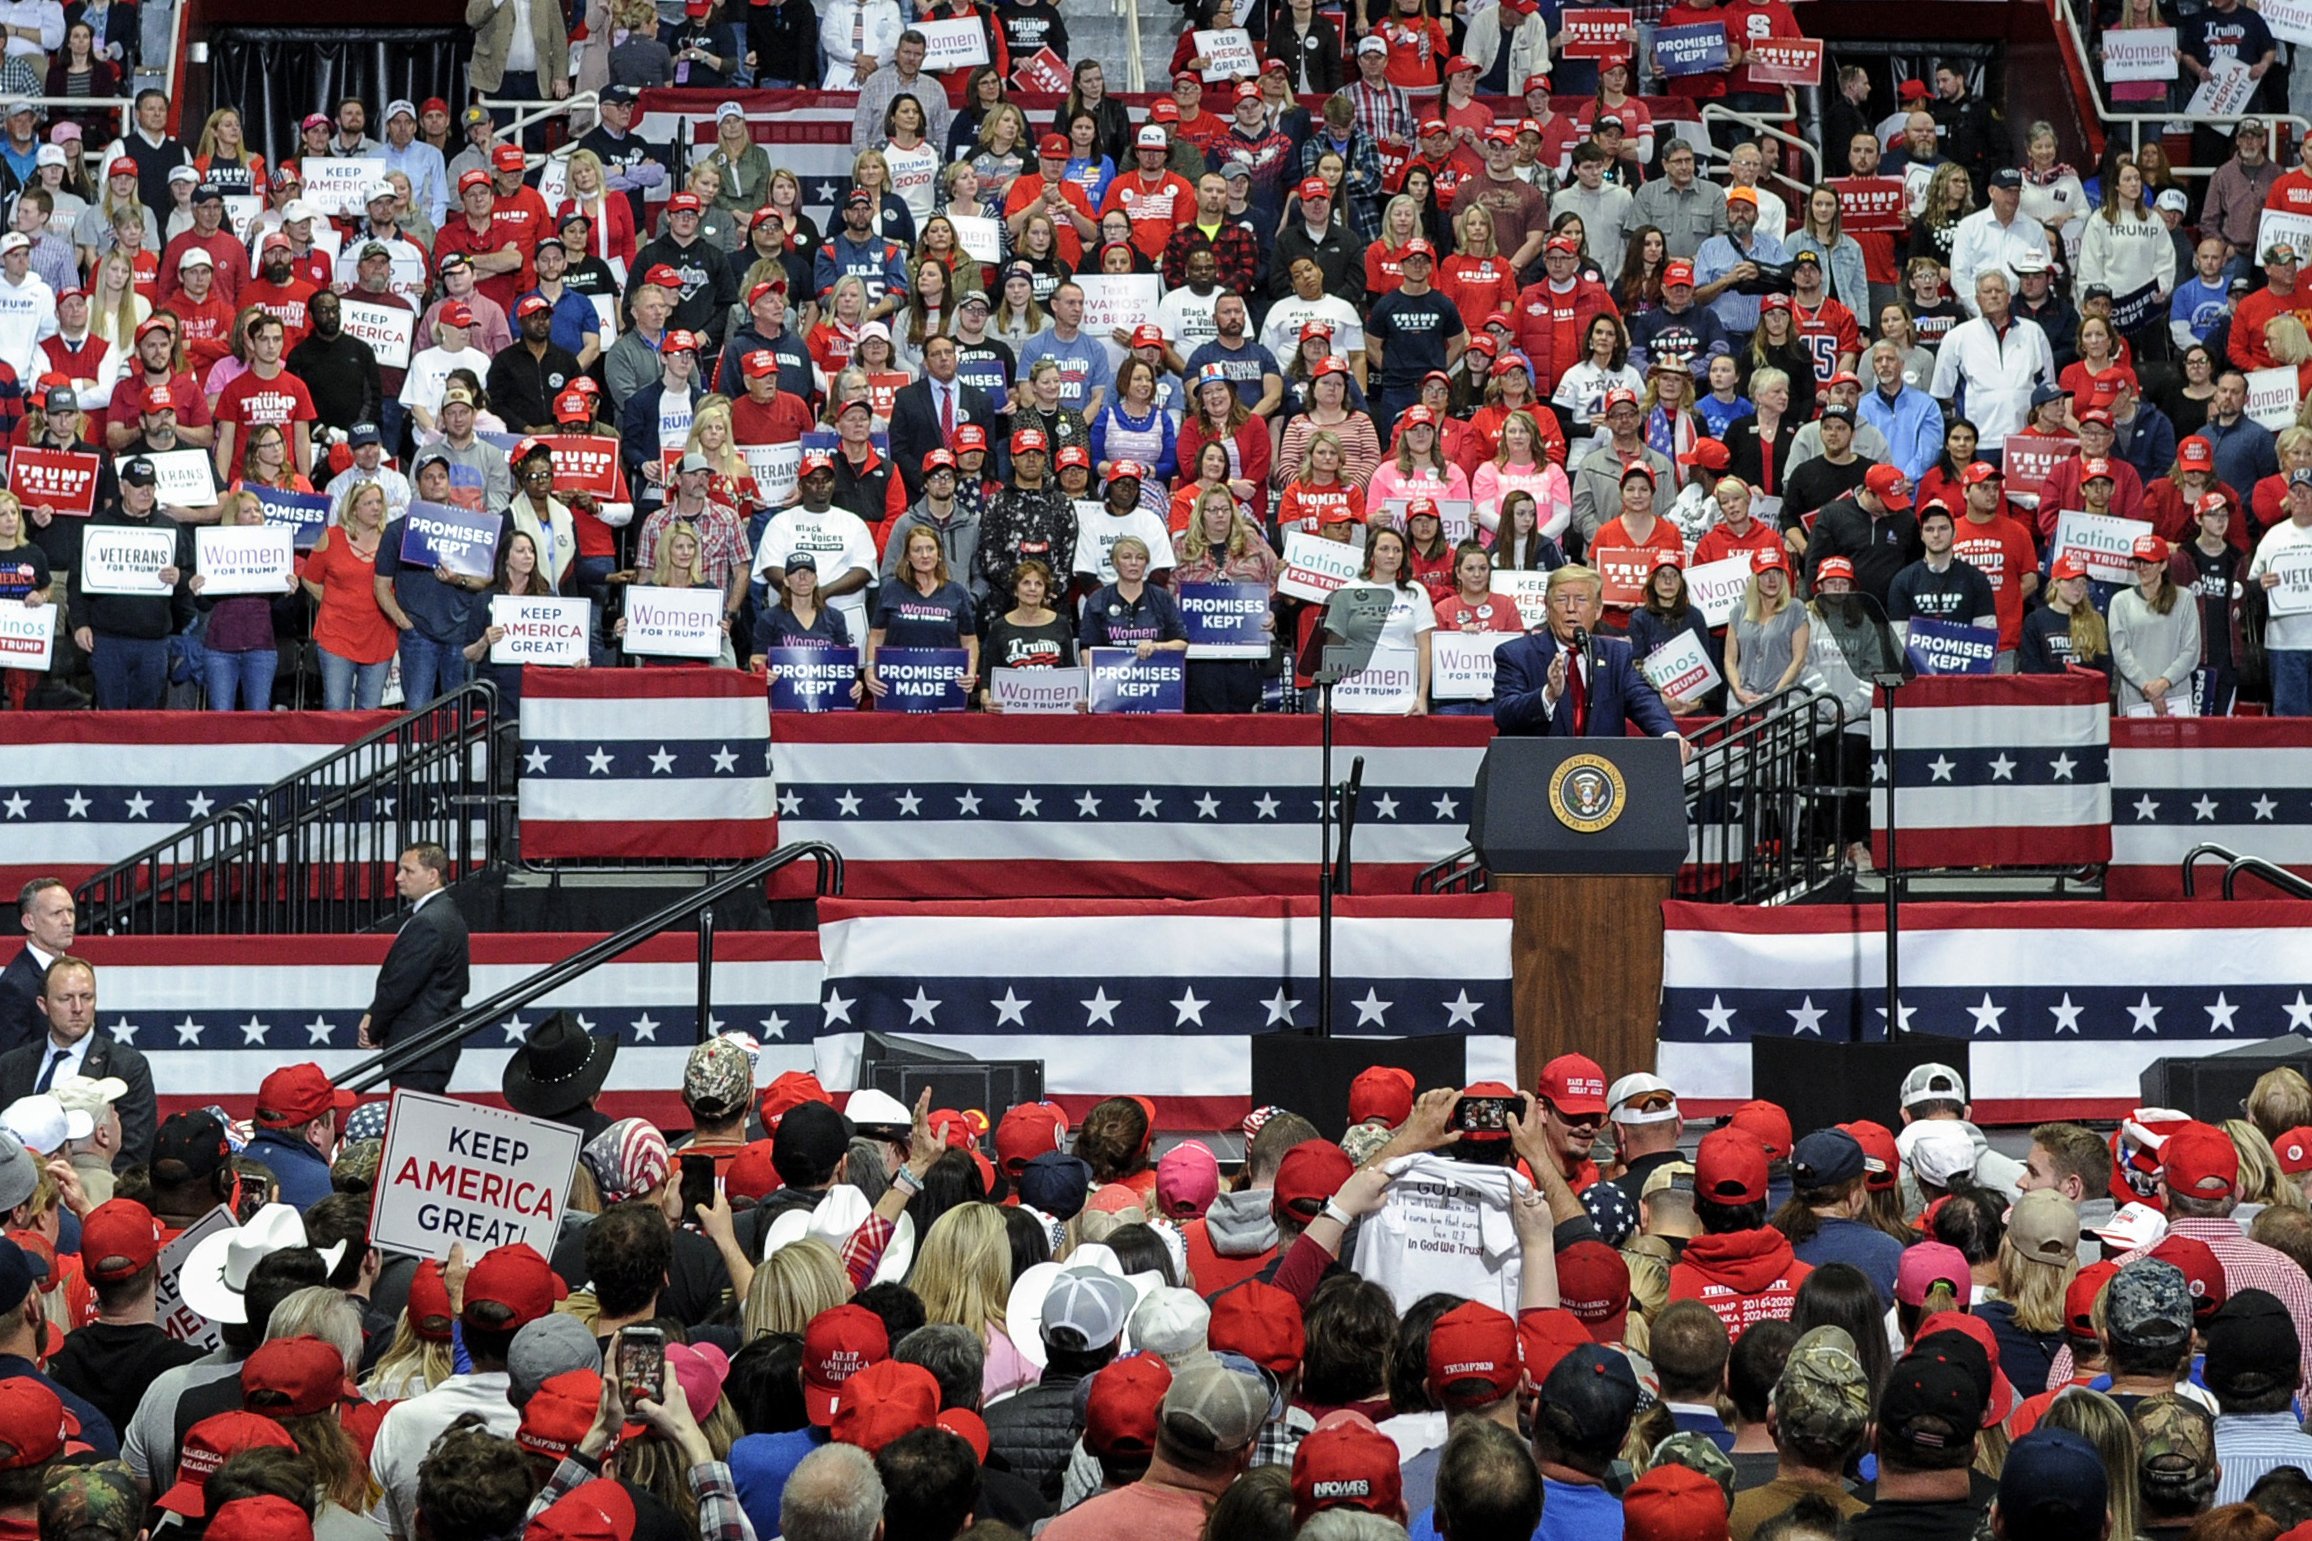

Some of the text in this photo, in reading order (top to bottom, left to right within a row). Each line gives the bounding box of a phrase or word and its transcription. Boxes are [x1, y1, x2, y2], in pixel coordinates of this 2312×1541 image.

[1009, 21, 1051, 32] TRUMP
[1568, 23, 1627, 33] TRUMP
[2204, 21, 2246, 38] Trump
[1214, 36, 1237, 47] KEEP
[1656, 34, 1724, 52] PROMISES
[1205, 48, 1253, 62] AMERICA
[1674, 50, 1708, 63] KEPT
[1756, 47, 1817, 60] TRUMP
[2108, 43, 2172, 60] Women
[2208, 44, 2239, 57] 2020
[1214, 61, 1251, 74] GREAT!
[1761, 57, 1810, 68] PENCE
[2139, 59, 2166, 67] TRUMP
[326, 167, 361, 177] KEEP
[891, 159, 933, 171] TRUMP
[895, 173, 932, 187] 2020
[308, 181, 371, 195] AMERIC
[1842, 192, 1899, 204] RUMP
[2167, 191, 2185, 204] USA
[2105, 224, 2159, 239] TRUMP
[1101, 284, 1130, 300] Text
[351, 311, 389, 325] KEEP
[1181, 308, 1209, 319] Black
[1392, 313, 1440, 322] TRUMP
[1084, 314, 1098, 328] to
[344, 324, 406, 344] MERICA
[1650, 337, 1699, 349] TRUMP
[1585, 379, 1624, 392] PRAY
[241, 396, 297, 412] TRUMP
[252, 409, 288, 420] PENCE
[550, 451, 612, 465] RUMP
[2010, 451, 2069, 466] TRUM
[17, 464, 92, 482] TRUMP
[556, 463, 605, 474] ENCE
[22, 478, 82, 493] PENCE
[765, 475, 797, 488] TRUMP
[1296, 489, 1348, 505] WOMEN
[261, 501, 326, 524] OMISES
[409, 515, 495, 546] PROMISES
[796, 525, 822, 537] Black
[426, 534, 471, 557] KEPT
[811, 534, 844, 546] Voices
[1974, 538, 2002, 550] BLESS
[100, 547, 168, 566] VETERANS
[203, 545, 286, 568] Women
[1290, 546, 1357, 580] Latino
[107, 564, 161, 575] FOR TRUMP
[213, 566, 278, 578] FOR TRUMP
[1603, 562, 1647, 576] TRU
[1291, 568, 1348, 589] FOR TRU
[1517, 579, 1547, 591] KEE
[1611, 575, 1647, 584] PEN
[900, 602, 952, 618] Women
[1182, 598, 1265, 615] PROMISES
[1708, 599, 1730, 611] FOR
[520, 607, 564, 621] KEEP
[633, 603, 715, 631] Women
[1201, 614, 1245, 630] KEPT
[502, 623, 584, 641] AMERICA
[640, 627, 706, 641] FOR TRUMP
[1107, 626, 1158, 642] Women
[1, 640, 42, 653] TRUMP
[782, 634, 833, 647] Women
[1909, 634, 1994, 660] PROMISES
[510, 641, 570, 655] GREAT!
[1006, 639, 1062, 657] Trump
[1440, 648, 1492, 671] Wom
[1928, 654, 1972, 673] KEPT
[772, 663, 857, 680] PROMISES
[878, 663, 965, 681] PROMISES
[1095, 664, 1182, 682] PROMISES
[1329, 660, 1411, 687] Women
[1448, 672, 1468, 681] FOR
[795, 680, 838, 696] KEPT
[895, 680, 946, 697] MADE
[1116, 682, 1160, 698] KEPT
[1337, 685, 1402, 697] FOR TRUMP
[1663, 670, 1705, 698] TRUMP
[998, 680, 1079, 703] Women
[1005, 700, 1071, 711] FOR TRUMP
[1552, 757, 1586, 793] PRESIDENT
[1607, 766, 1624, 800] UNITED
[1593, 805, 1623, 830] STATES
[448, 1125, 530, 1168] KEEP
[394, 1155, 554, 1221] AMERICA
[1417, 1182, 1460, 1198] GOD
[417, 1203, 528, 1247] GREAT!
[1408, 1238, 1485, 1257] In God We Trust
[1582, 1299, 1611, 1309] AMERICA
[1584, 1309, 1607, 1317] AGAIN
[832, 1350, 860, 1361] KEEP
[820, 1360, 870, 1372] AMERICA
[1443, 1361, 1494, 1375] TRUMP2020
[1313, 1479, 1370, 1499] INFOWARS
